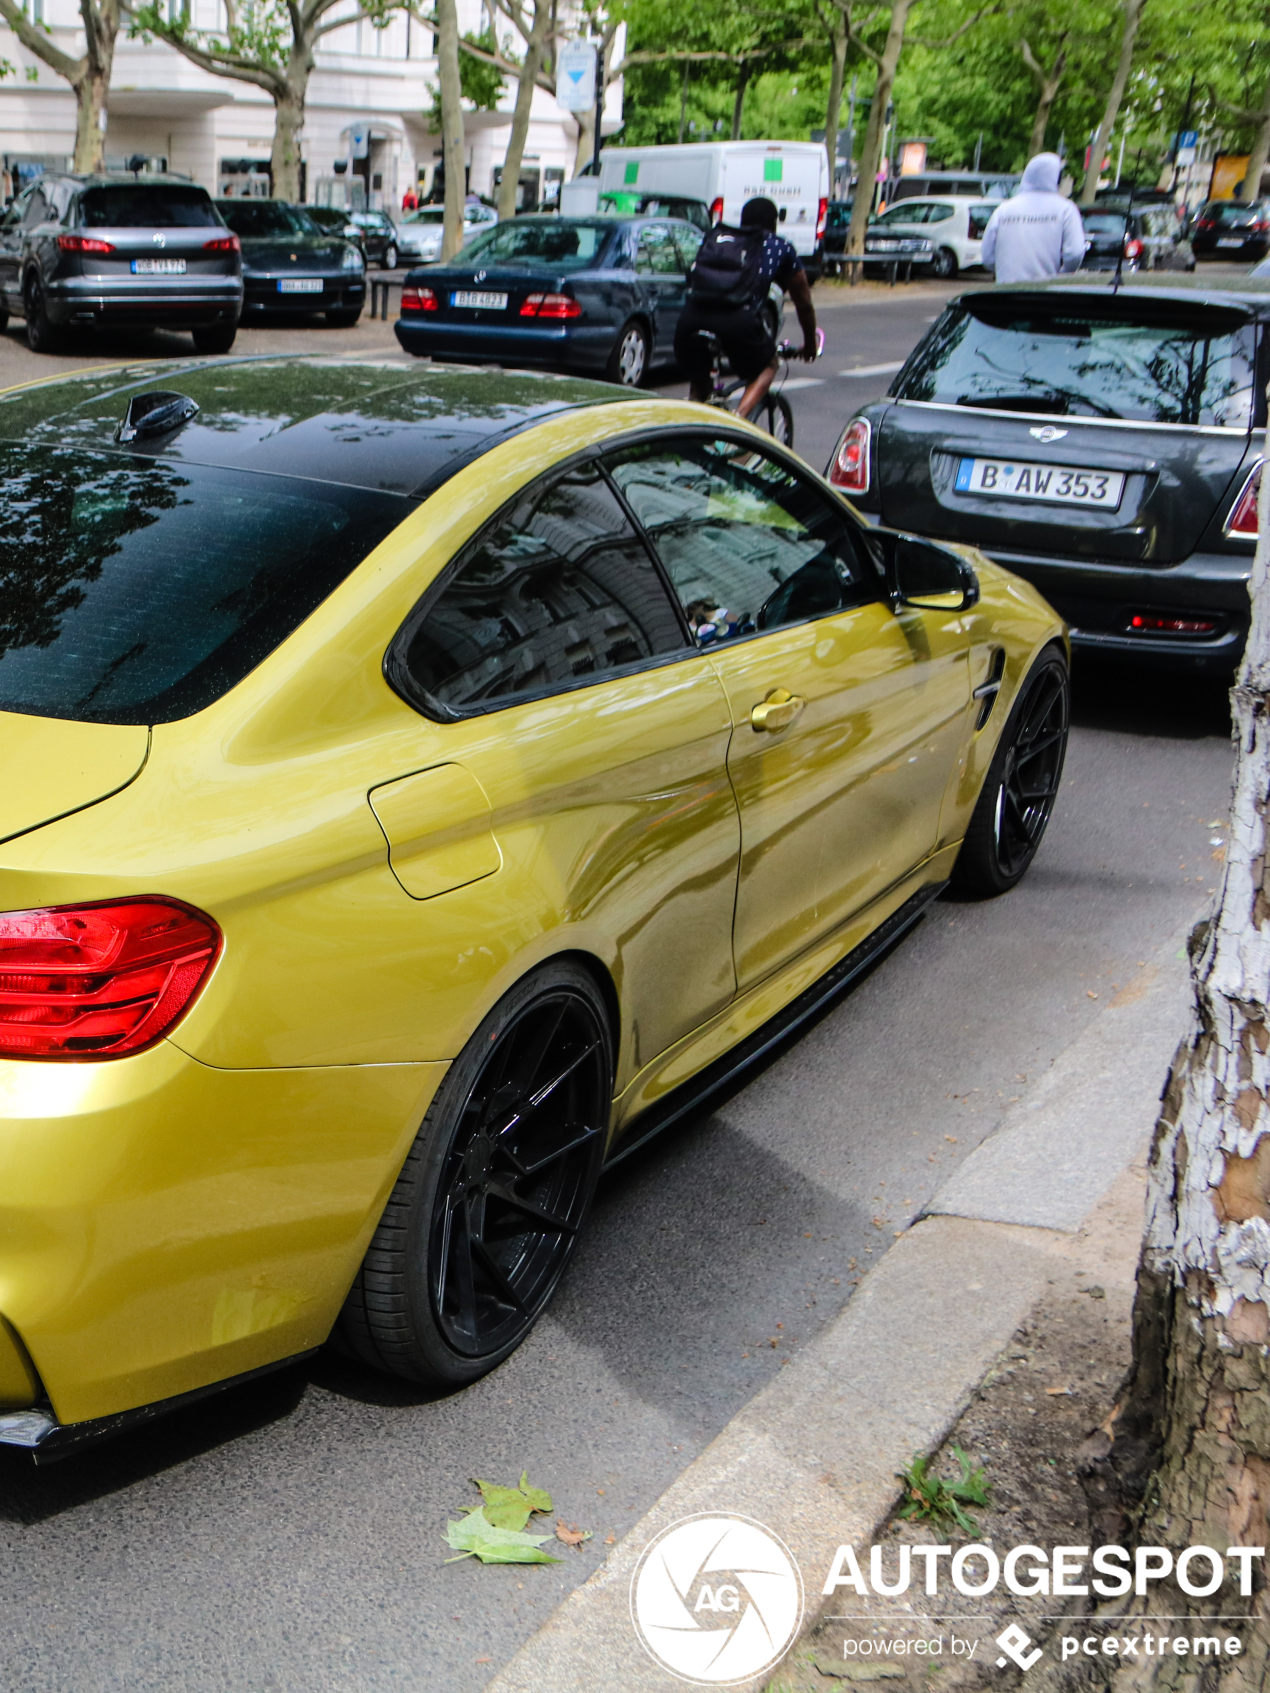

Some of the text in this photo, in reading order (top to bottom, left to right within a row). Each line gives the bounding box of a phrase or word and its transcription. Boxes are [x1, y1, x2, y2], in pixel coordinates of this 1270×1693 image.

[981, 465, 999, 488] B
[1015, 468, 1054, 494] AW
[1056, 471, 1110, 500] 353
